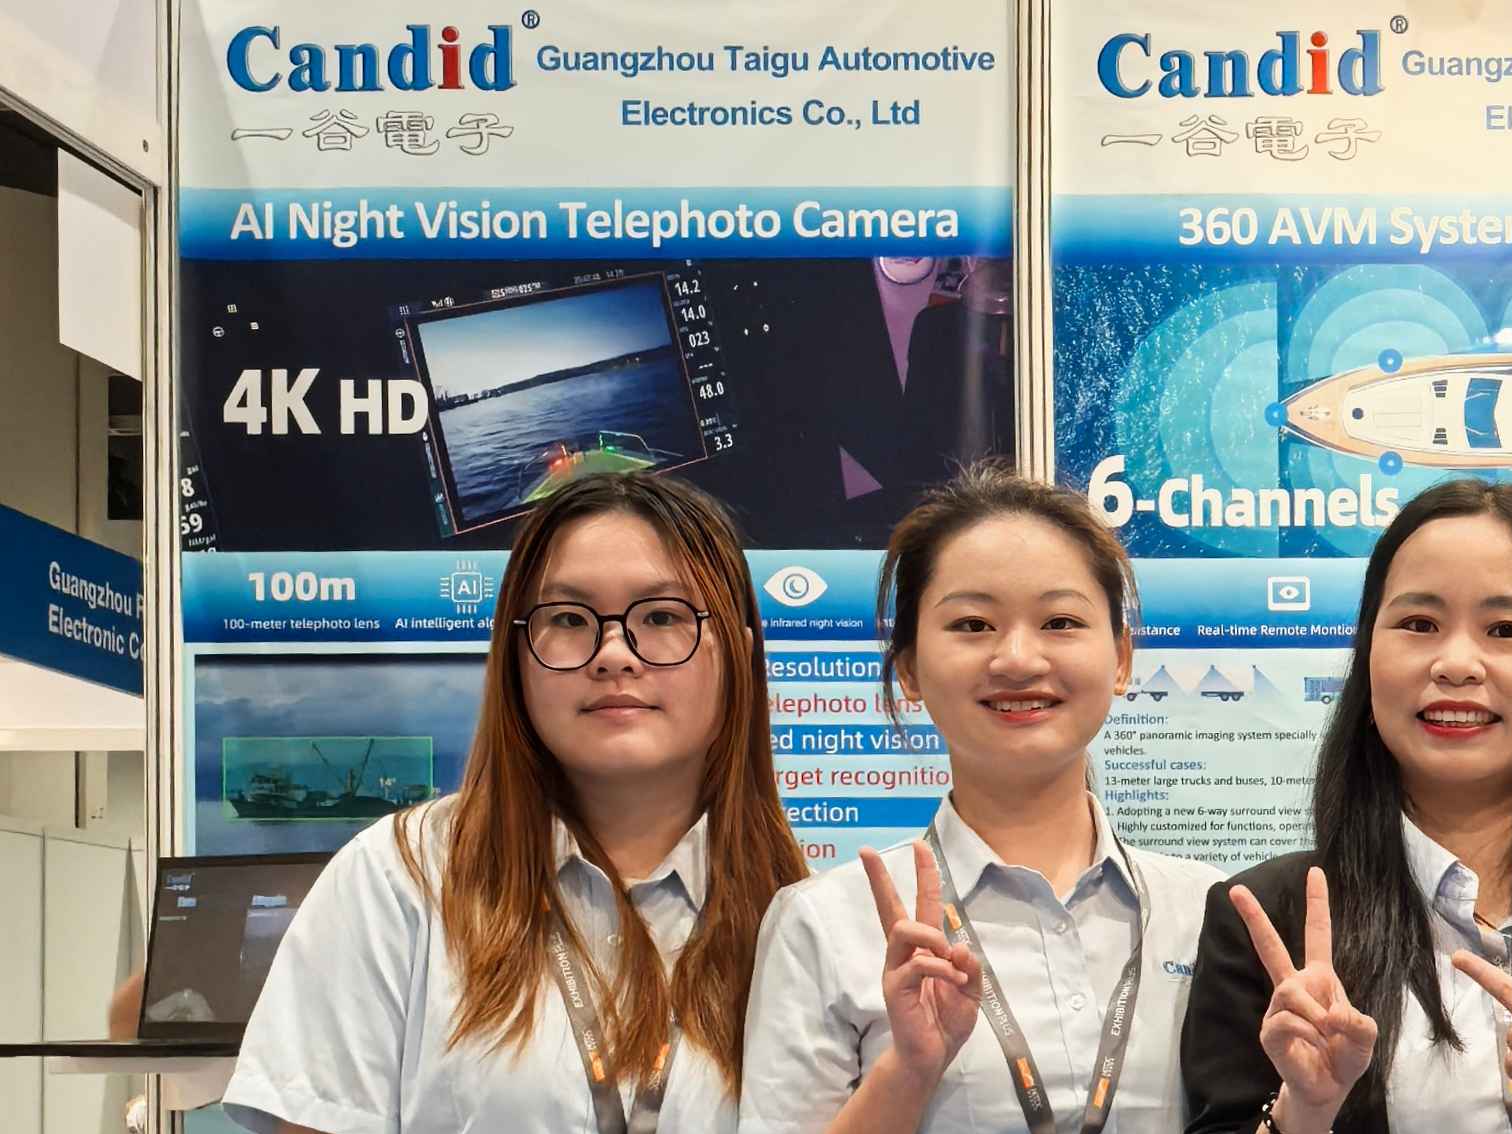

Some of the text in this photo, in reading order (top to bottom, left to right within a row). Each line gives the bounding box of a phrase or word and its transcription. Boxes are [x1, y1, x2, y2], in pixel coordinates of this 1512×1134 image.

[226, 24, 517, 92] Candid
[537, 45, 995, 78] Guangzhou Taigu Automotive
[1098, 30, 1386, 98] Candid
[622, 100, 920, 130] Electronics Co., Ltd
[230, 200, 959, 248] AI Night Vision Telephoto Camera
[1179, 208, 1258, 245] 360
[1268, 208, 1377, 245] AVM
[675, 280, 701, 296] 14.2
[681, 306, 706, 321] 14.0
[689, 332, 710, 348] 023
[699, 382, 724, 399] 48.0
[223, 369, 428, 434] 4K HD
[714, 434, 733, 451] 3.3
[1088, 455, 1401, 527] 6-Channels
[49, 561, 132, 617] Guangzhou
[249, 572, 356, 602] 100m
[457, 580, 477, 594] AI
[49, 603, 125, 655] Electronic
[223, 618, 380, 631] 100-meter telephoto lens
[411, 617, 474, 631] intelligent
[771, 617, 863, 630] infrared night vision
[1198, 624, 1307, 637] Real-time Remote
[1104, 713, 1169, 725] Definition:
[802, 729, 940, 753] night vision
[1104, 730, 1317, 742] A panoramic imaging system specially
[1105, 759, 1207, 771] Successful cases:
[1105, 776, 1267, 788] 13-meter large trucks and buses,
[1105, 790, 1169, 803] Highlights:
[1117, 807, 1162, 818] Adopting
[1197, 807, 1228, 818] 6-way
[1231, 806, 1276, 816] surround
[1278, 806, 1301, 816] view
[1117, 821, 1276, 833] Highly customized for functions,
[1139, 836, 1297, 848] surround view system can cover
[1194, 851, 1228, 863] variety
[1231, 851, 1242, 861] of
